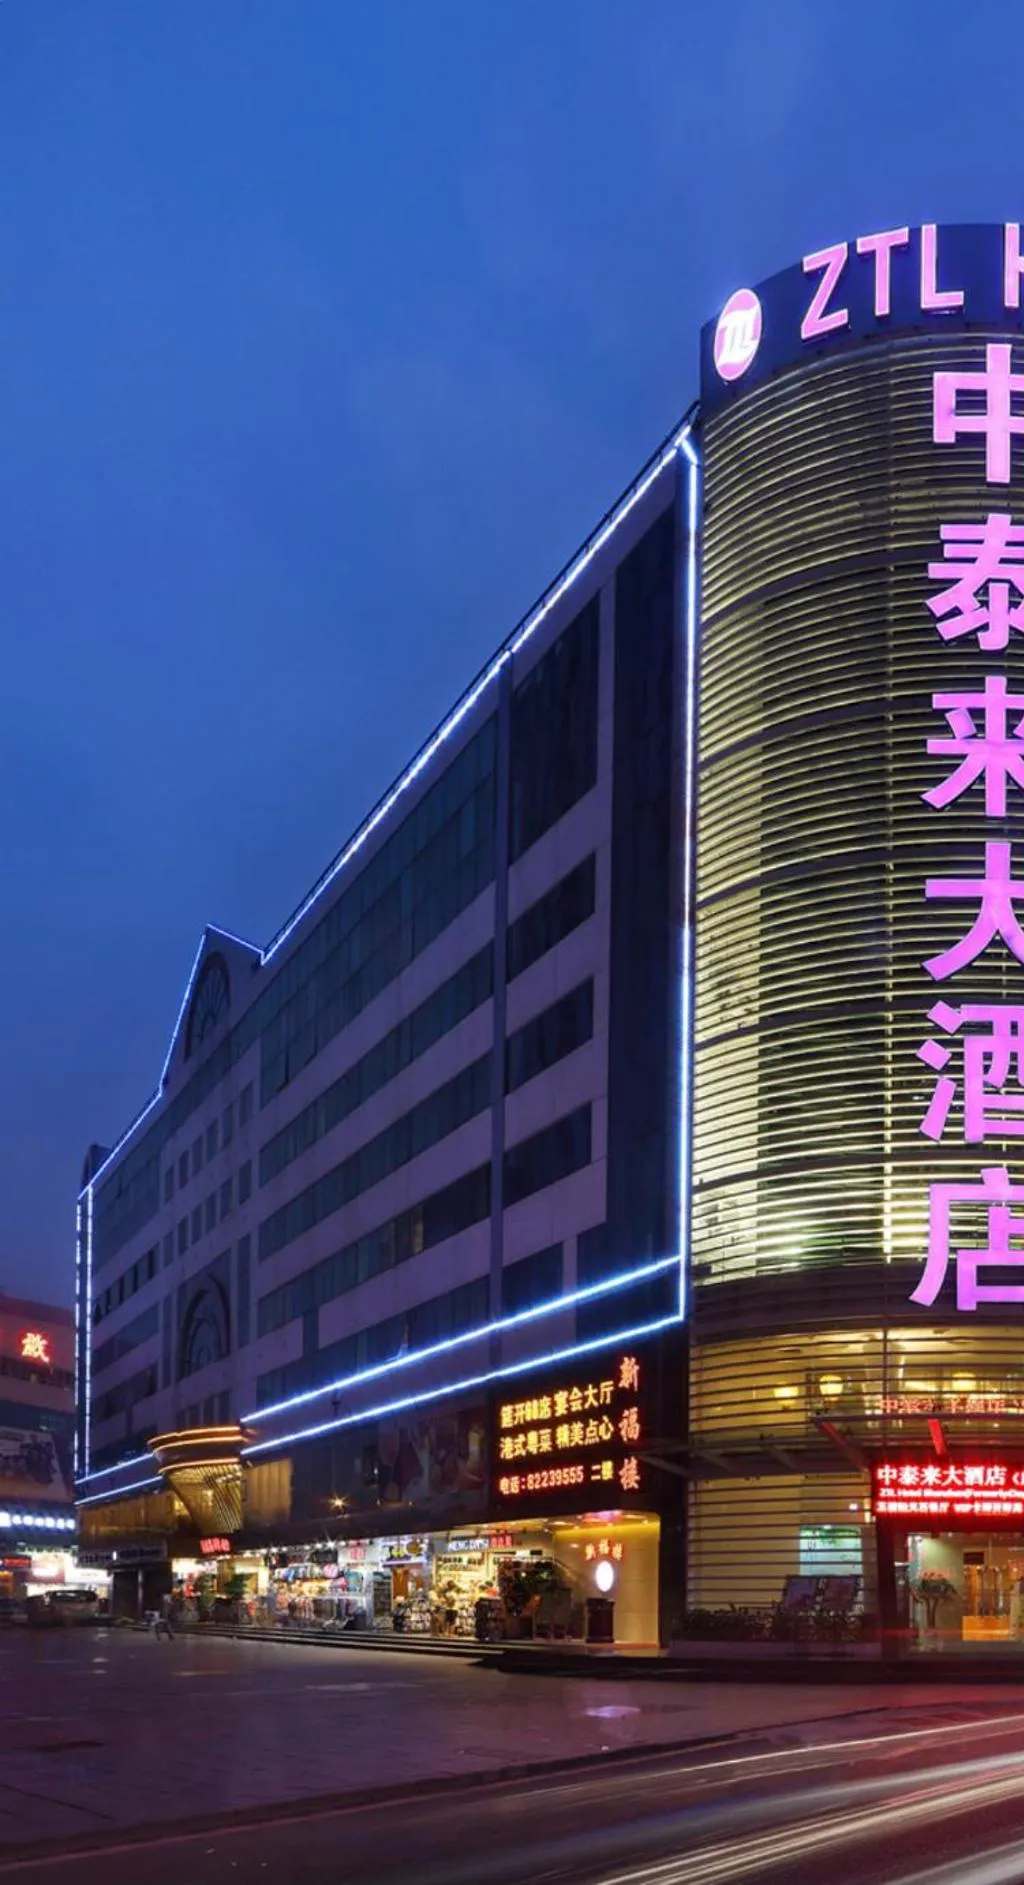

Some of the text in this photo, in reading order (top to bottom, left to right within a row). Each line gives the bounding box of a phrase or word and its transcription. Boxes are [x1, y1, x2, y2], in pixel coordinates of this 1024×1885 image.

[801, 223, 964, 341] ZTL
[554, 1380, 615, 1418] 宴会大厅
[499, 1415, 615, 1460] 港式粤菜 精美点心
[877, 1464, 1007, 1486] 中泰来大酒店
